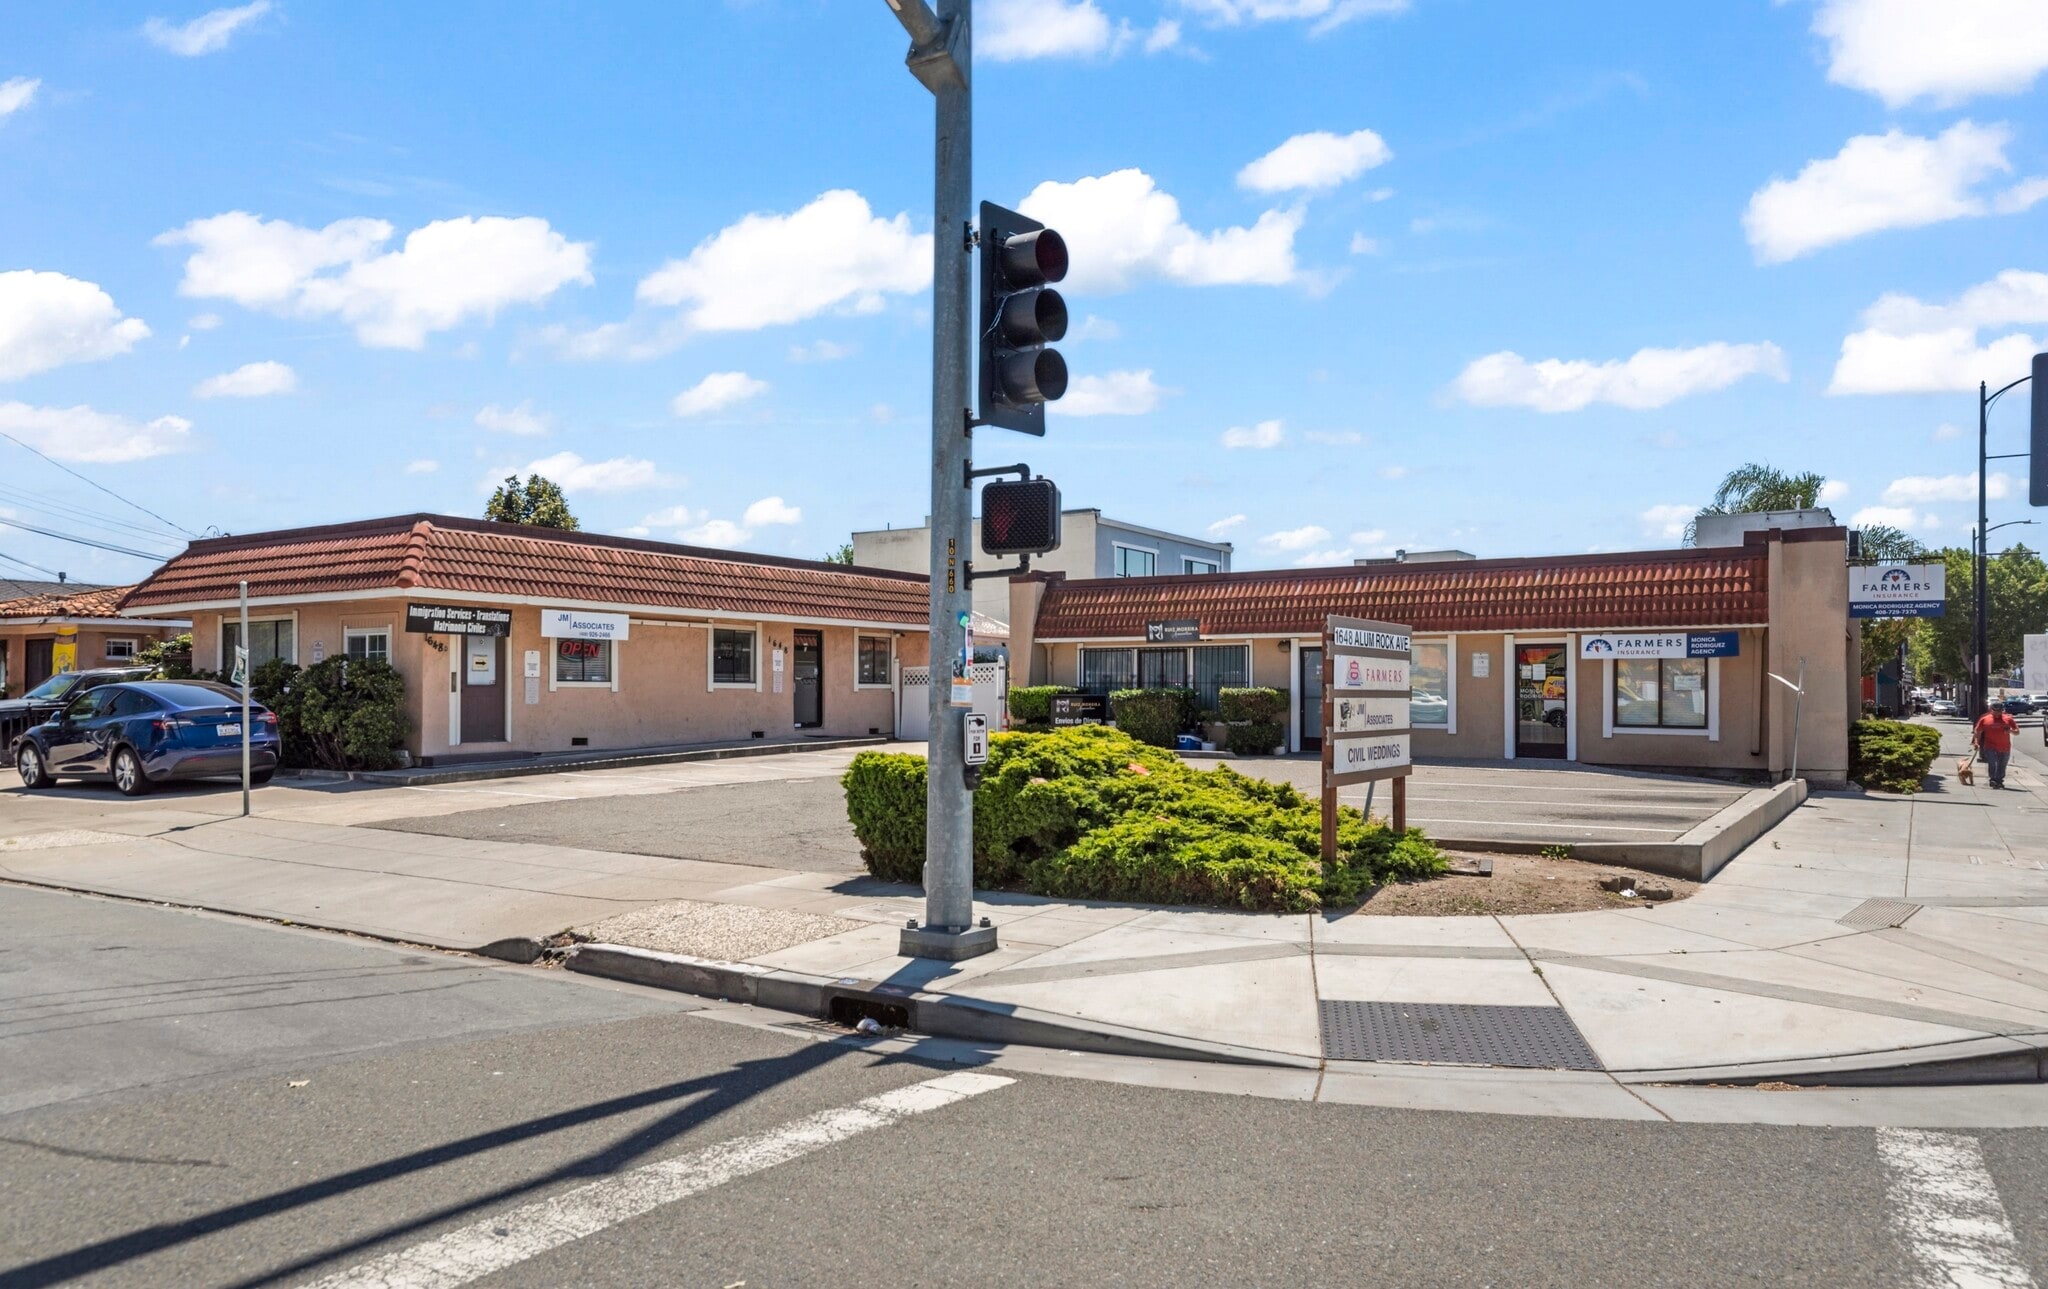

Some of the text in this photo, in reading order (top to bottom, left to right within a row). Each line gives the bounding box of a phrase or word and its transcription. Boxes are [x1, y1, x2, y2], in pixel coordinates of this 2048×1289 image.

[1862, 582, 1931, 592] FARMERS
[409, 605, 510, 622] Immigration Services Translations
[558, 613, 569, 622] JM
[433, 620, 486, 634] Matrimonio Civiles
[572, 621, 615, 631] ASSOCIATES
[1335, 629, 1409, 651] 1648 ALUM ROCK AVE
[1617, 638, 1683, 648] FARMERS
[561, 641, 601, 657] OPEN
[1366, 668, 1402, 683] FARMERS
[1074, 716, 1082, 724] de
[1348, 743, 1401, 763] CIVIL WEDDINGS
